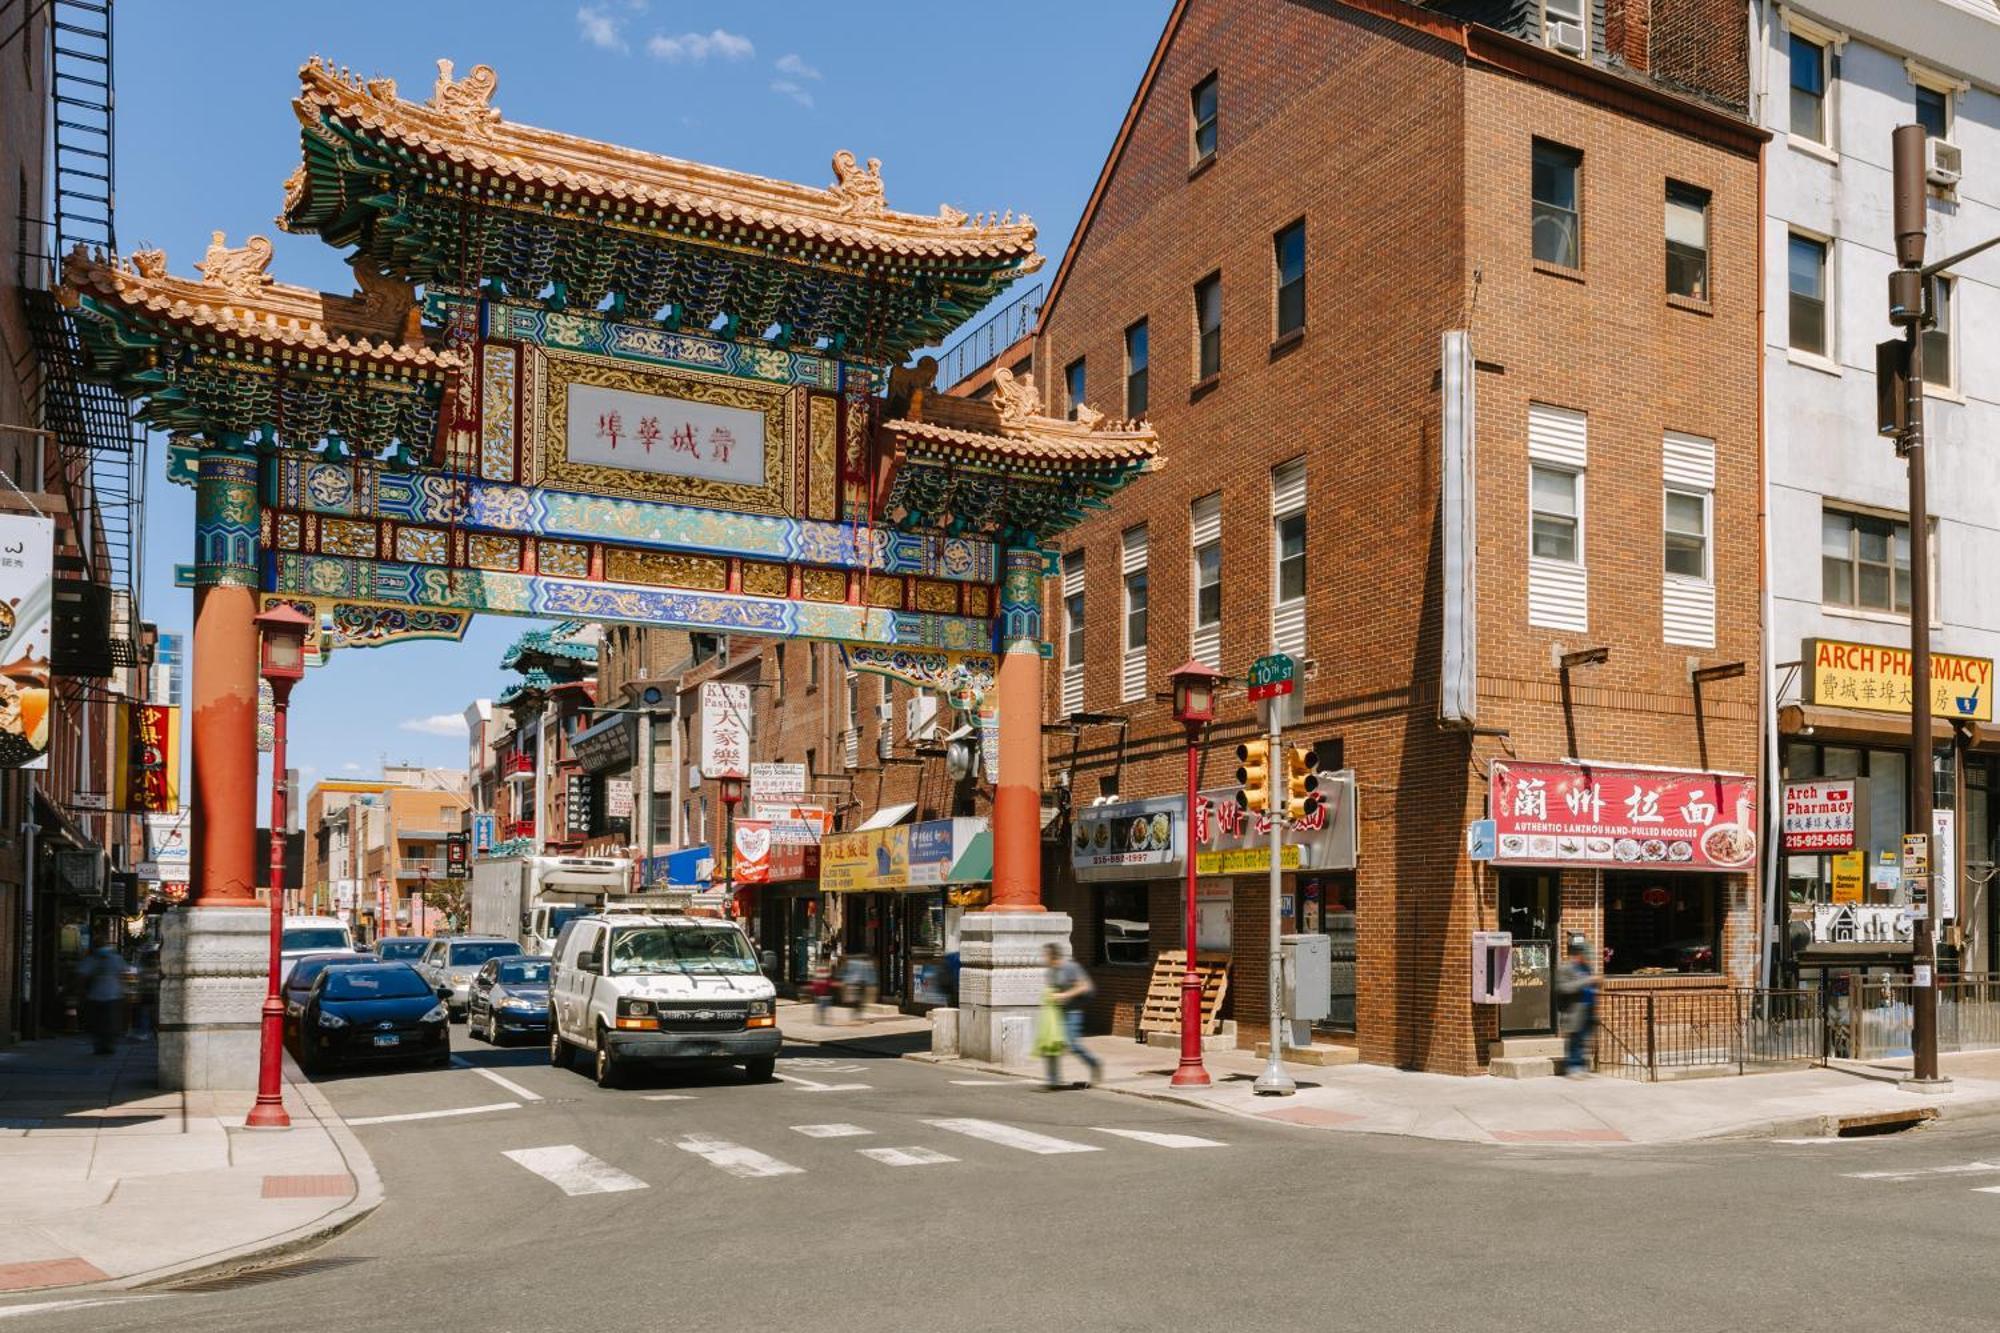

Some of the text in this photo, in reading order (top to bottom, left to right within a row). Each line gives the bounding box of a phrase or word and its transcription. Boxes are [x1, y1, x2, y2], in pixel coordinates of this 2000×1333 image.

[1817, 644, 1874, 673] ARCH
[1282, 666, 1292, 679] ST
[1823, 673, 1949, 711] 費城華埠大房
[704, 698, 748, 709] Pastries
[1786, 786, 1818, 800] Arch
[1787, 801, 1853, 815] Pharmacy
[1514, 822, 1698, 838] AUTHENTIC LANZHOU HAND-PULLED NOODLES
[1786, 833, 1853, 848] 215-925-9666
